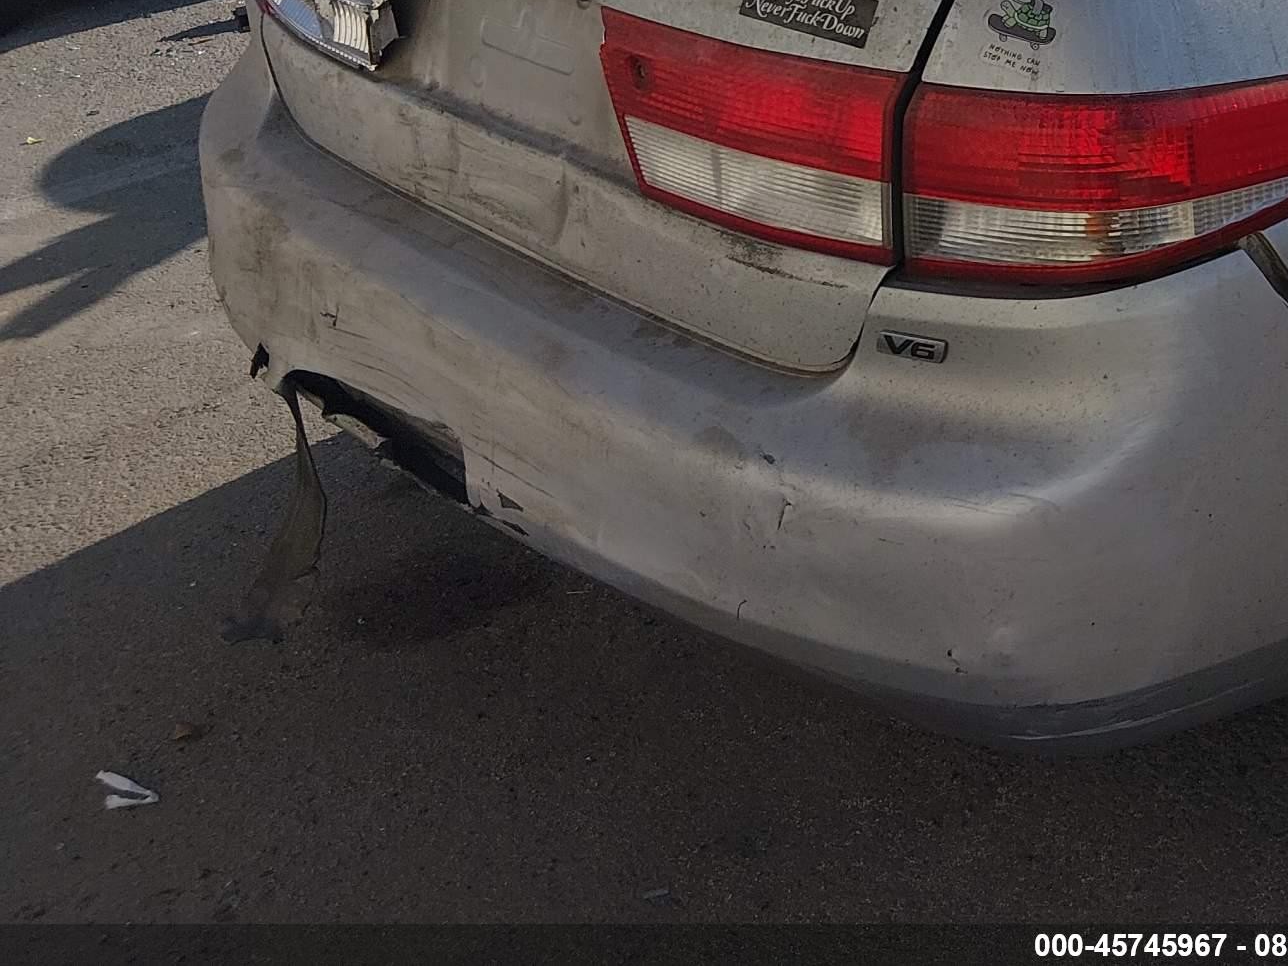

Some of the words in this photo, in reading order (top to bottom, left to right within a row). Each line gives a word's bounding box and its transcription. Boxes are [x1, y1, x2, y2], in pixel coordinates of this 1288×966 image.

[783, 3, 822, 27] Fuck
[820, 13, 865, 39] Down
[1005, 59, 1016, 68] ME
[1027, 57, 1041, 66] CAN
[884, 334, 936, 360] V6
